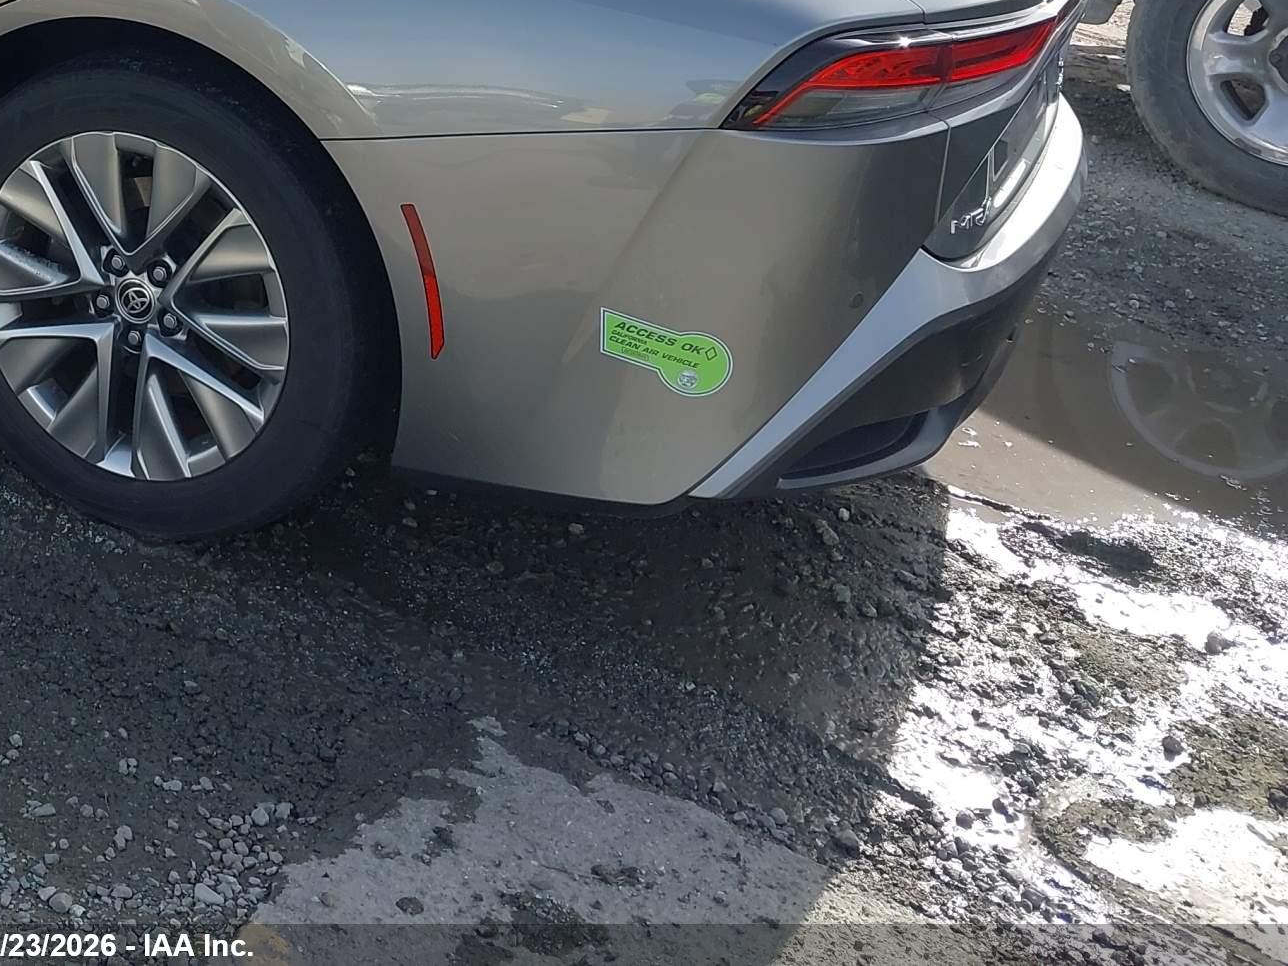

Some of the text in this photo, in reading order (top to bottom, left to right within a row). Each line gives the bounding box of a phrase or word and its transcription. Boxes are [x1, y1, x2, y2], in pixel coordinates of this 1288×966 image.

[608, 335, 642, 351] CLEAN
[642, 347, 660, 356] AIR
[662, 352, 701, 369] VEHICLE
[614, 320, 705, 355] ACCESS OK
